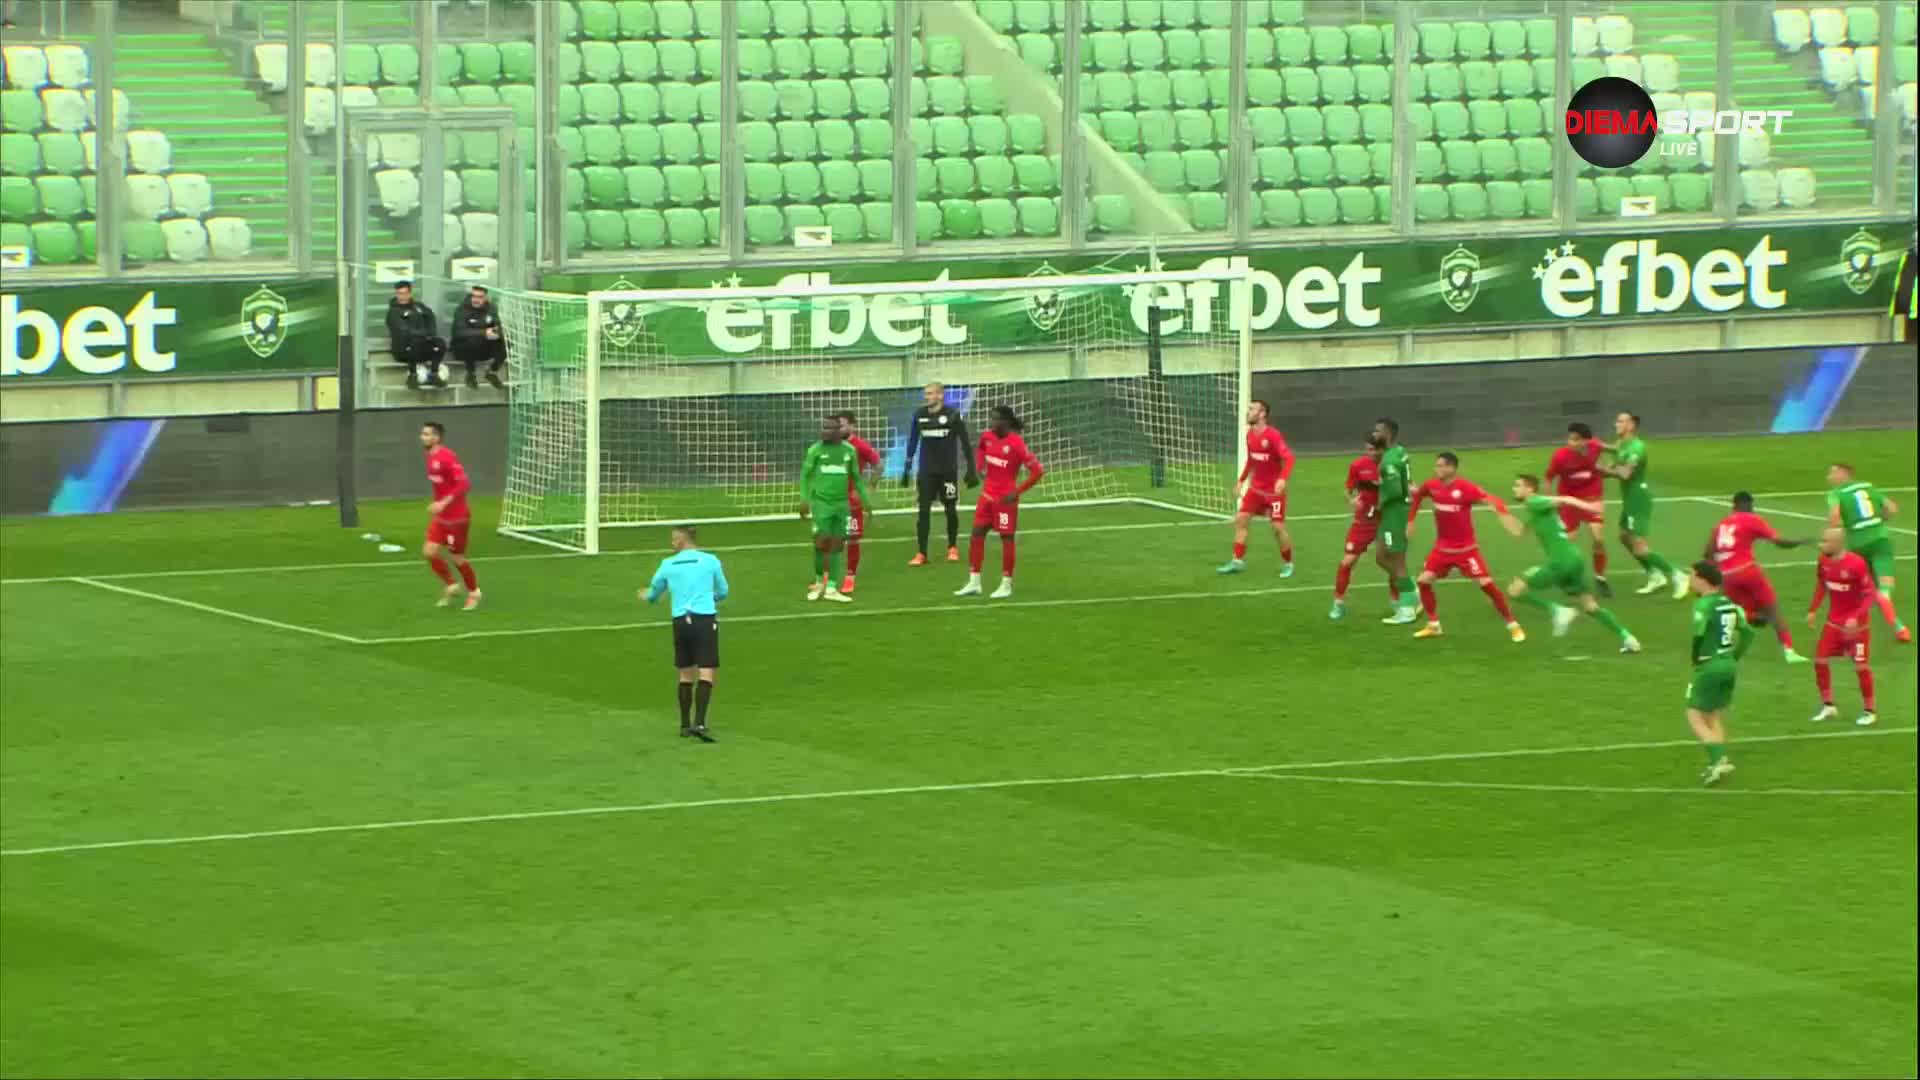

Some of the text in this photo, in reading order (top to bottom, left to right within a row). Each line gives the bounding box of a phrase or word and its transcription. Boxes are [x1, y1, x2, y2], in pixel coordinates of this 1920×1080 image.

[706, 268, 968, 353] efbet
[1131, 251, 1382, 336] efbet
[1541, 235, 1788, 318] efbet
